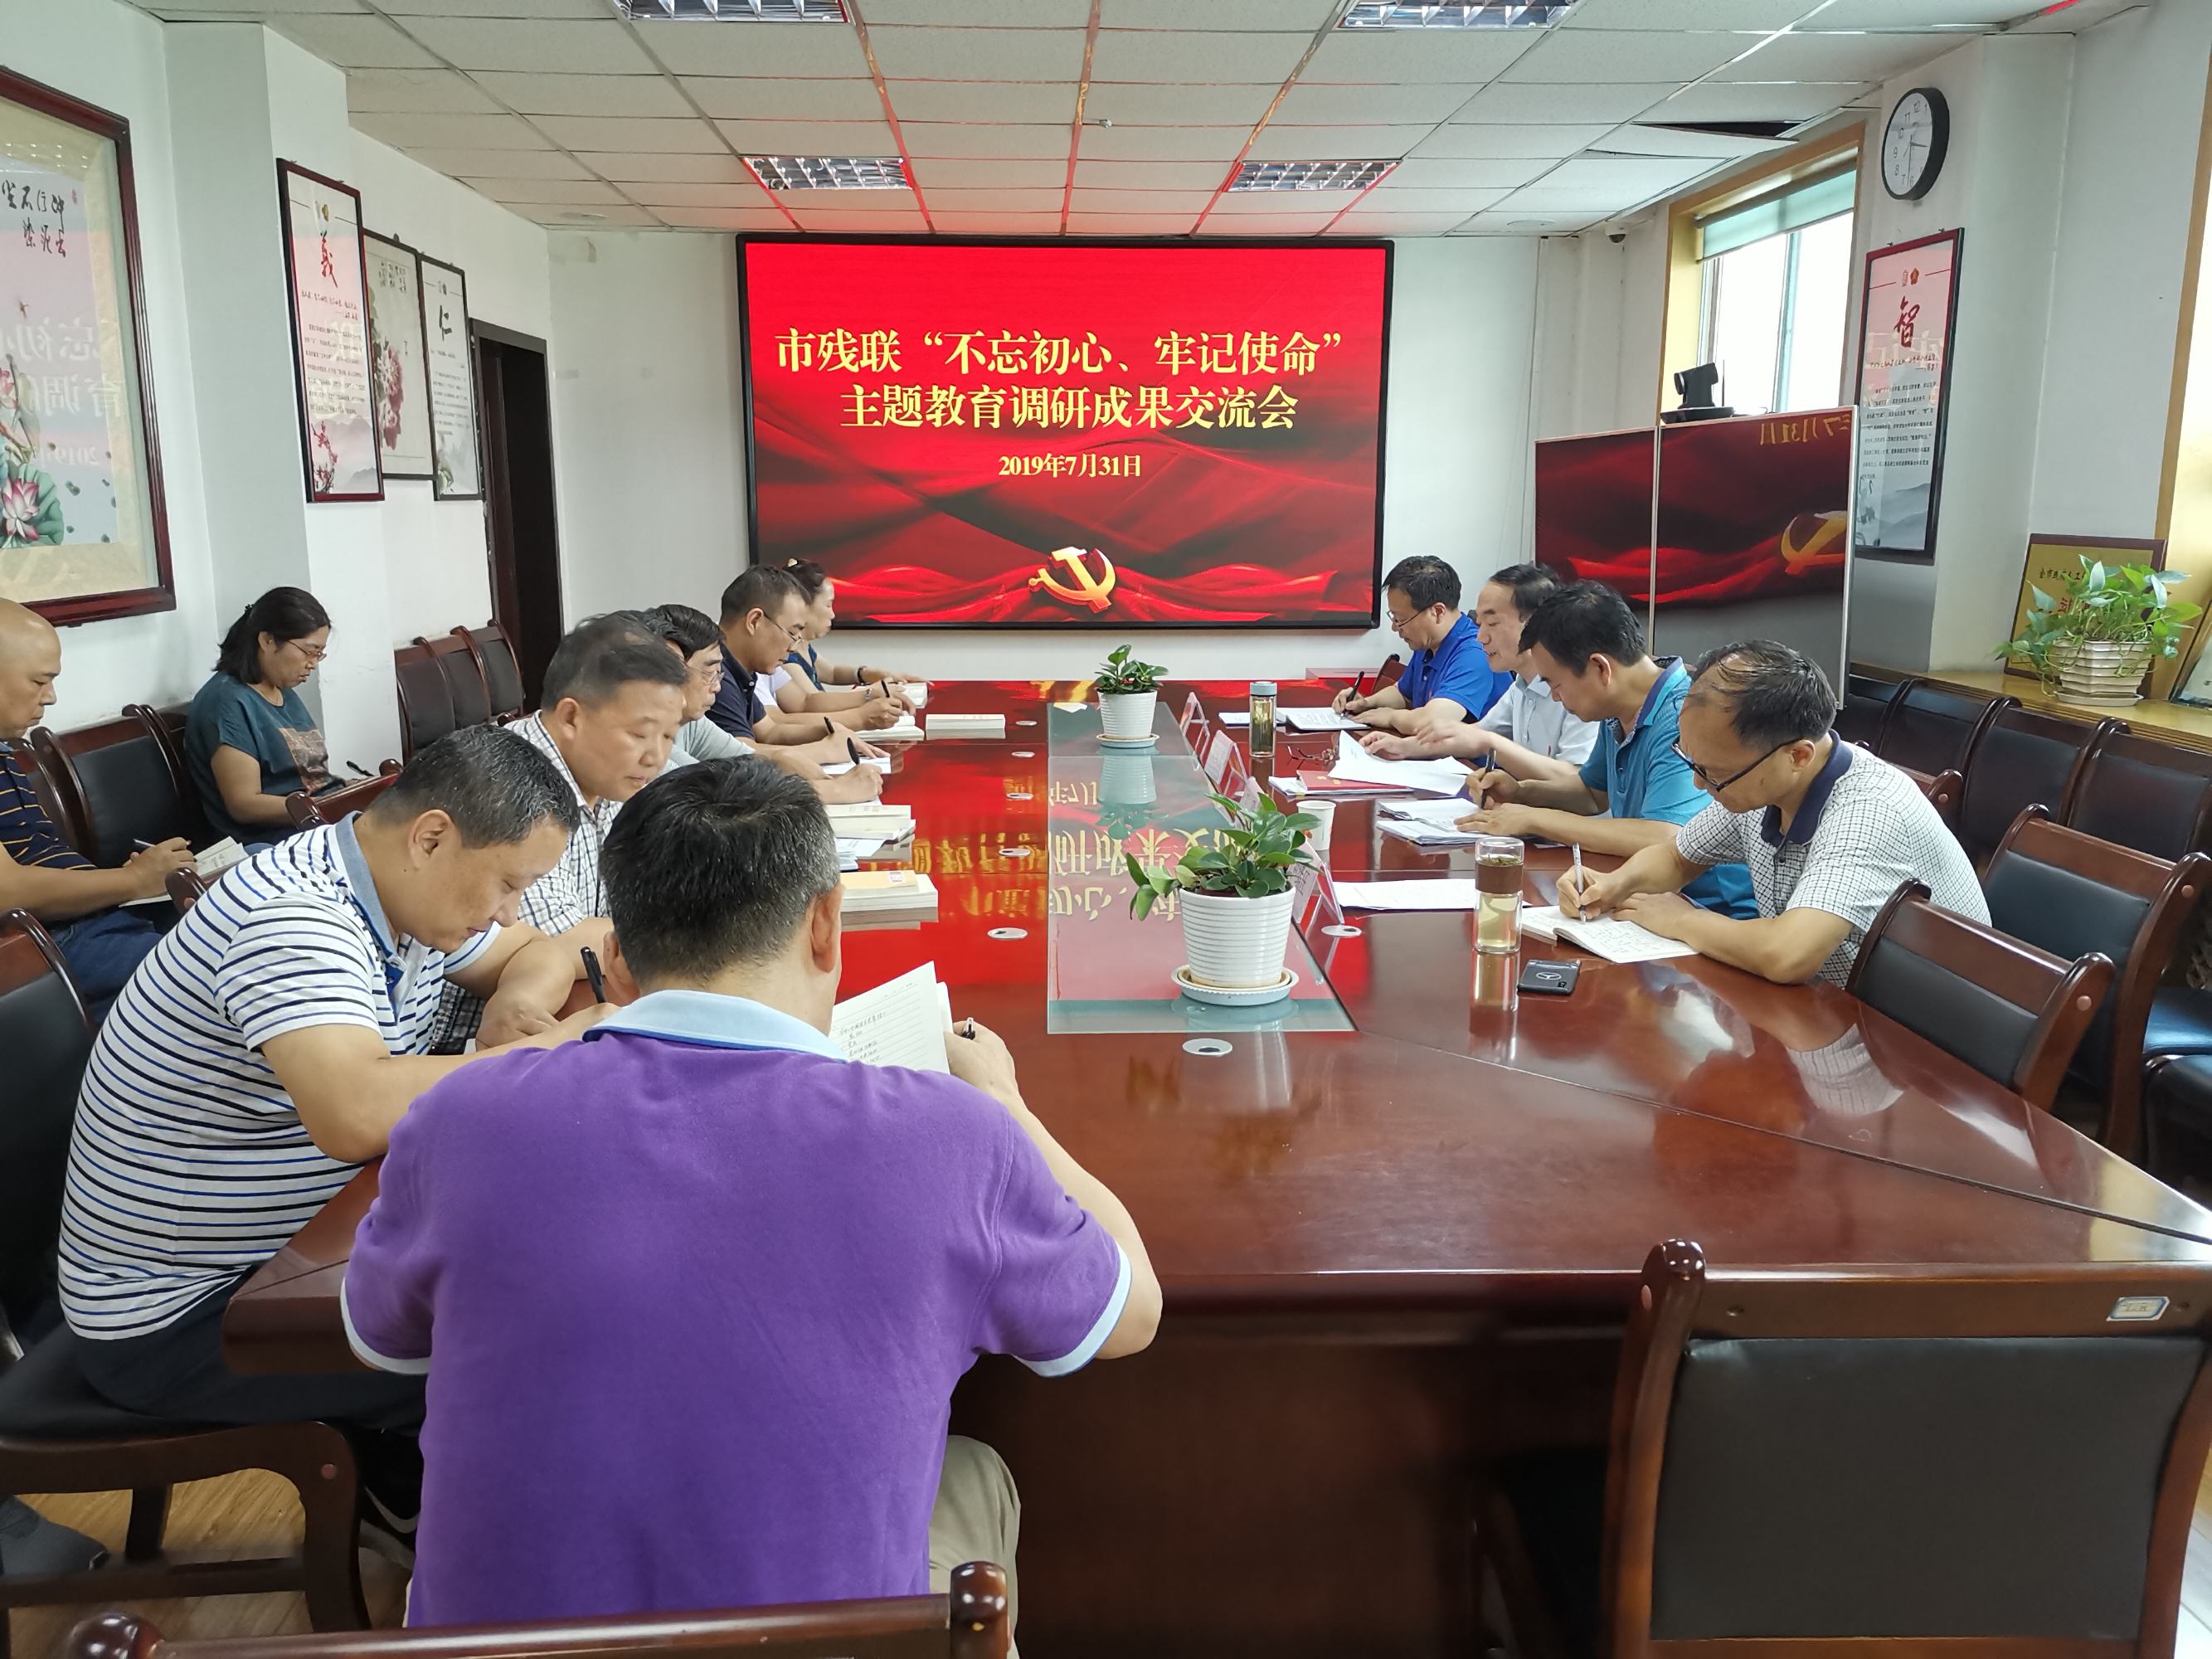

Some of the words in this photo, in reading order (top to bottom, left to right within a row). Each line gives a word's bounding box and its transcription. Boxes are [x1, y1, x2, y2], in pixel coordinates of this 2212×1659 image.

[1894, 295, 1921, 348] 智
[840, 383, 1299, 429] 主题教育调研成果交流会
[998, 453, 1141, 478] 2019年7月31日
